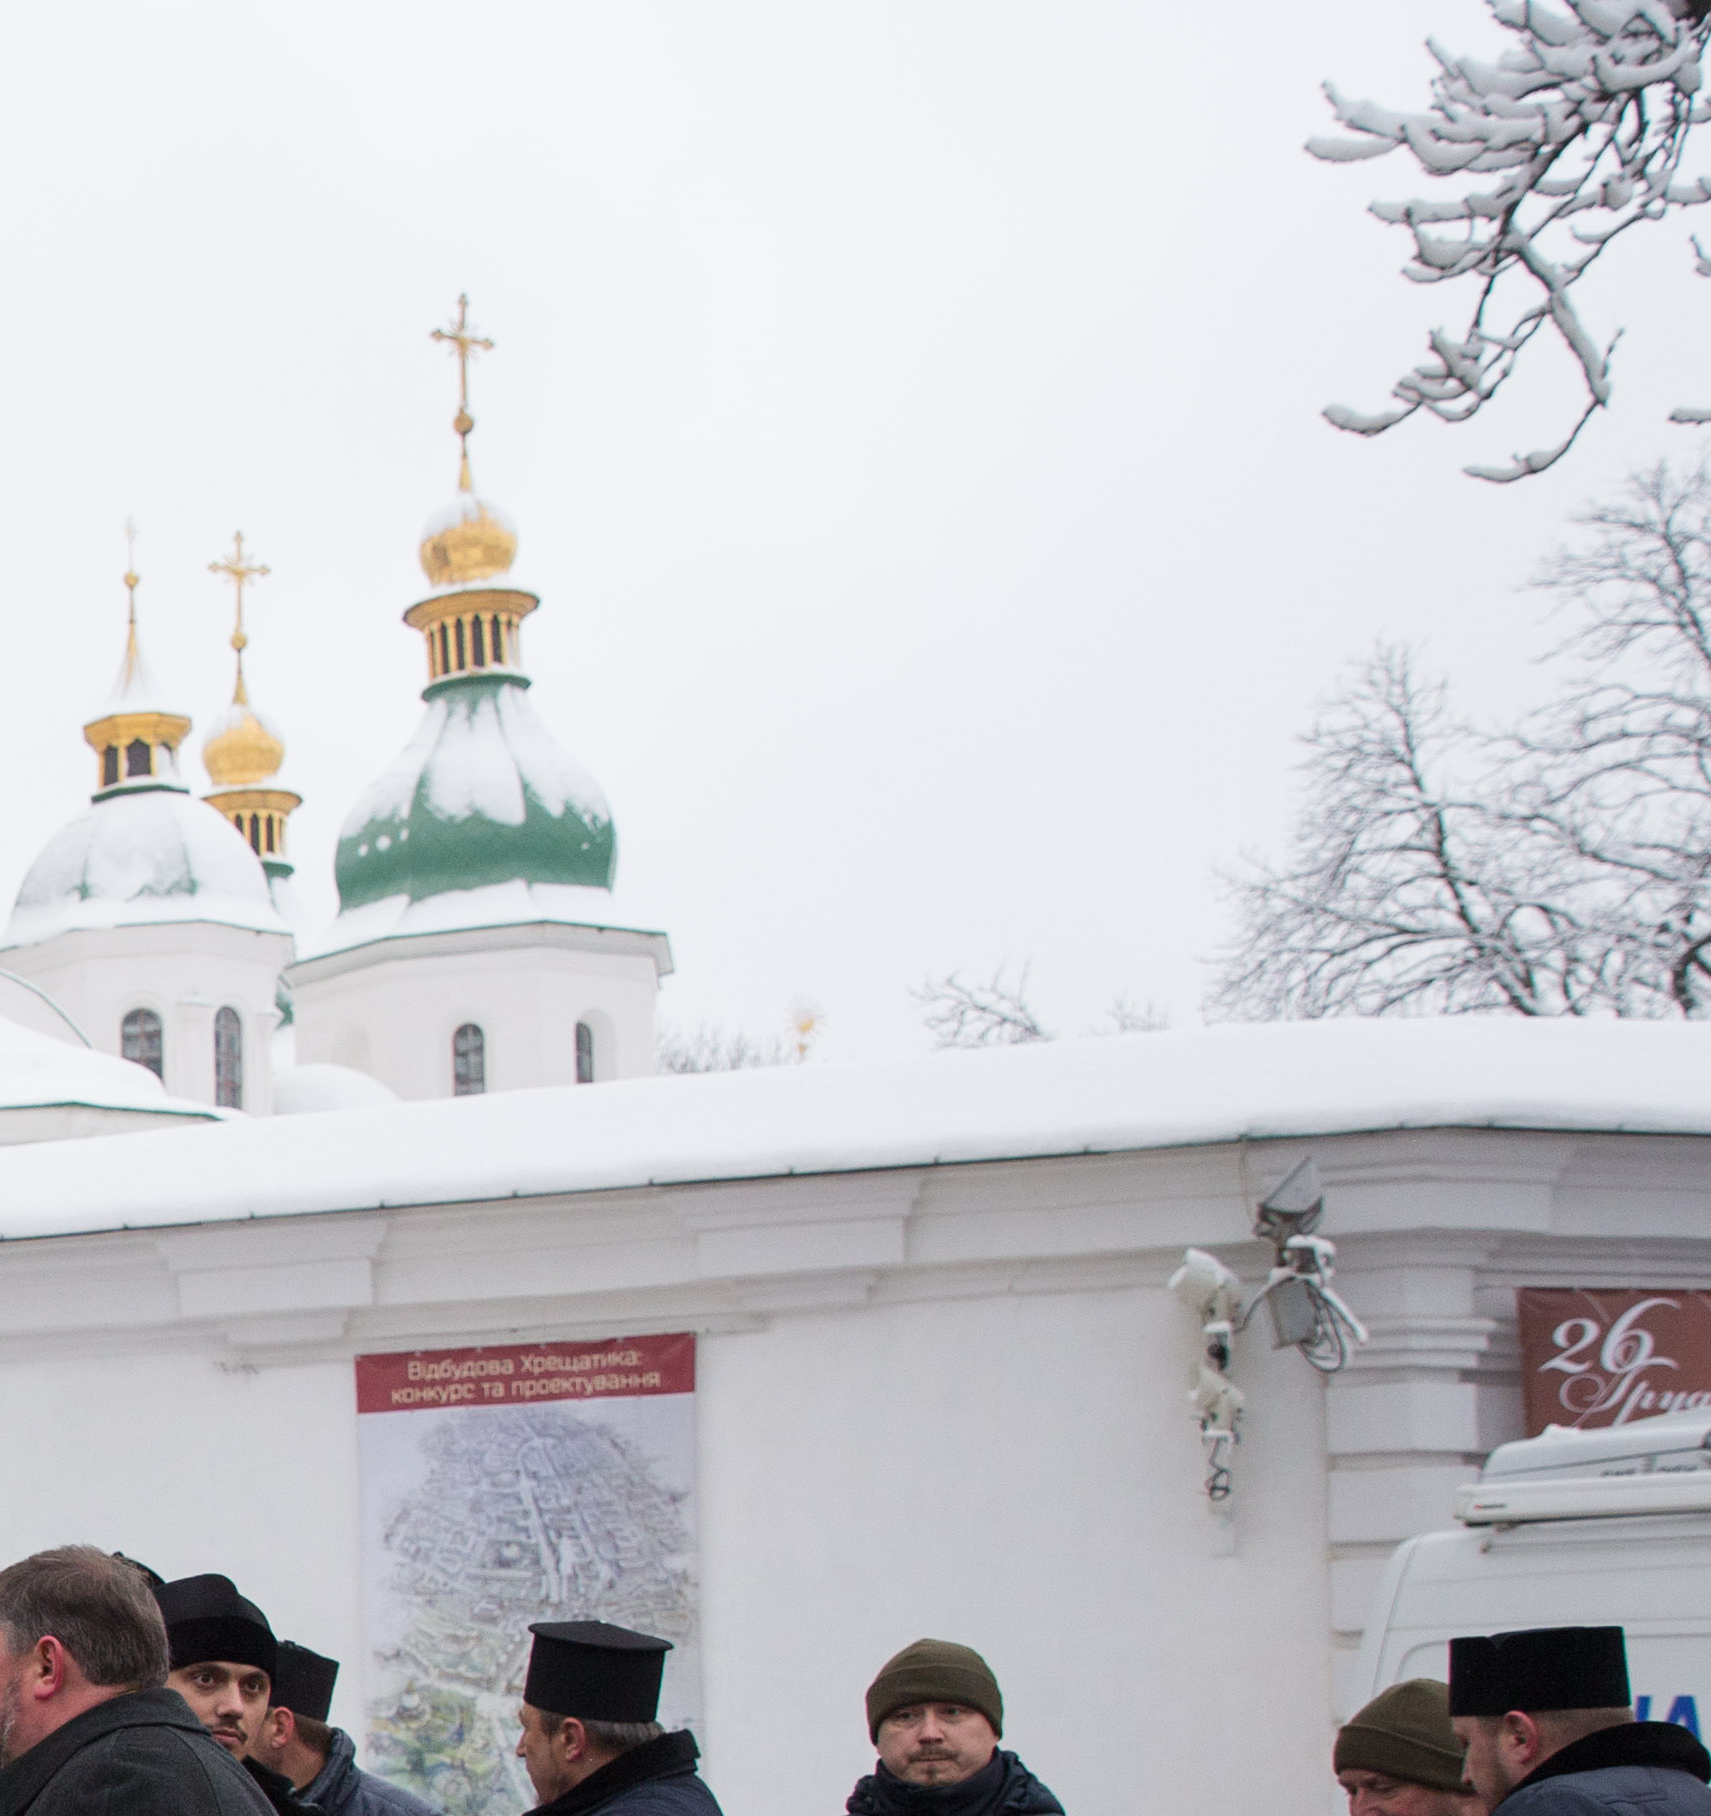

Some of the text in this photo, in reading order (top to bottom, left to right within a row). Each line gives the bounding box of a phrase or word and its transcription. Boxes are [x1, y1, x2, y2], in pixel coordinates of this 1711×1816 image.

[1538, 1297, 1681, 1374] 26
[407, 1359, 514, 1382] Відбудова
[391, 1371, 661, 1404] конкурс та проектування
